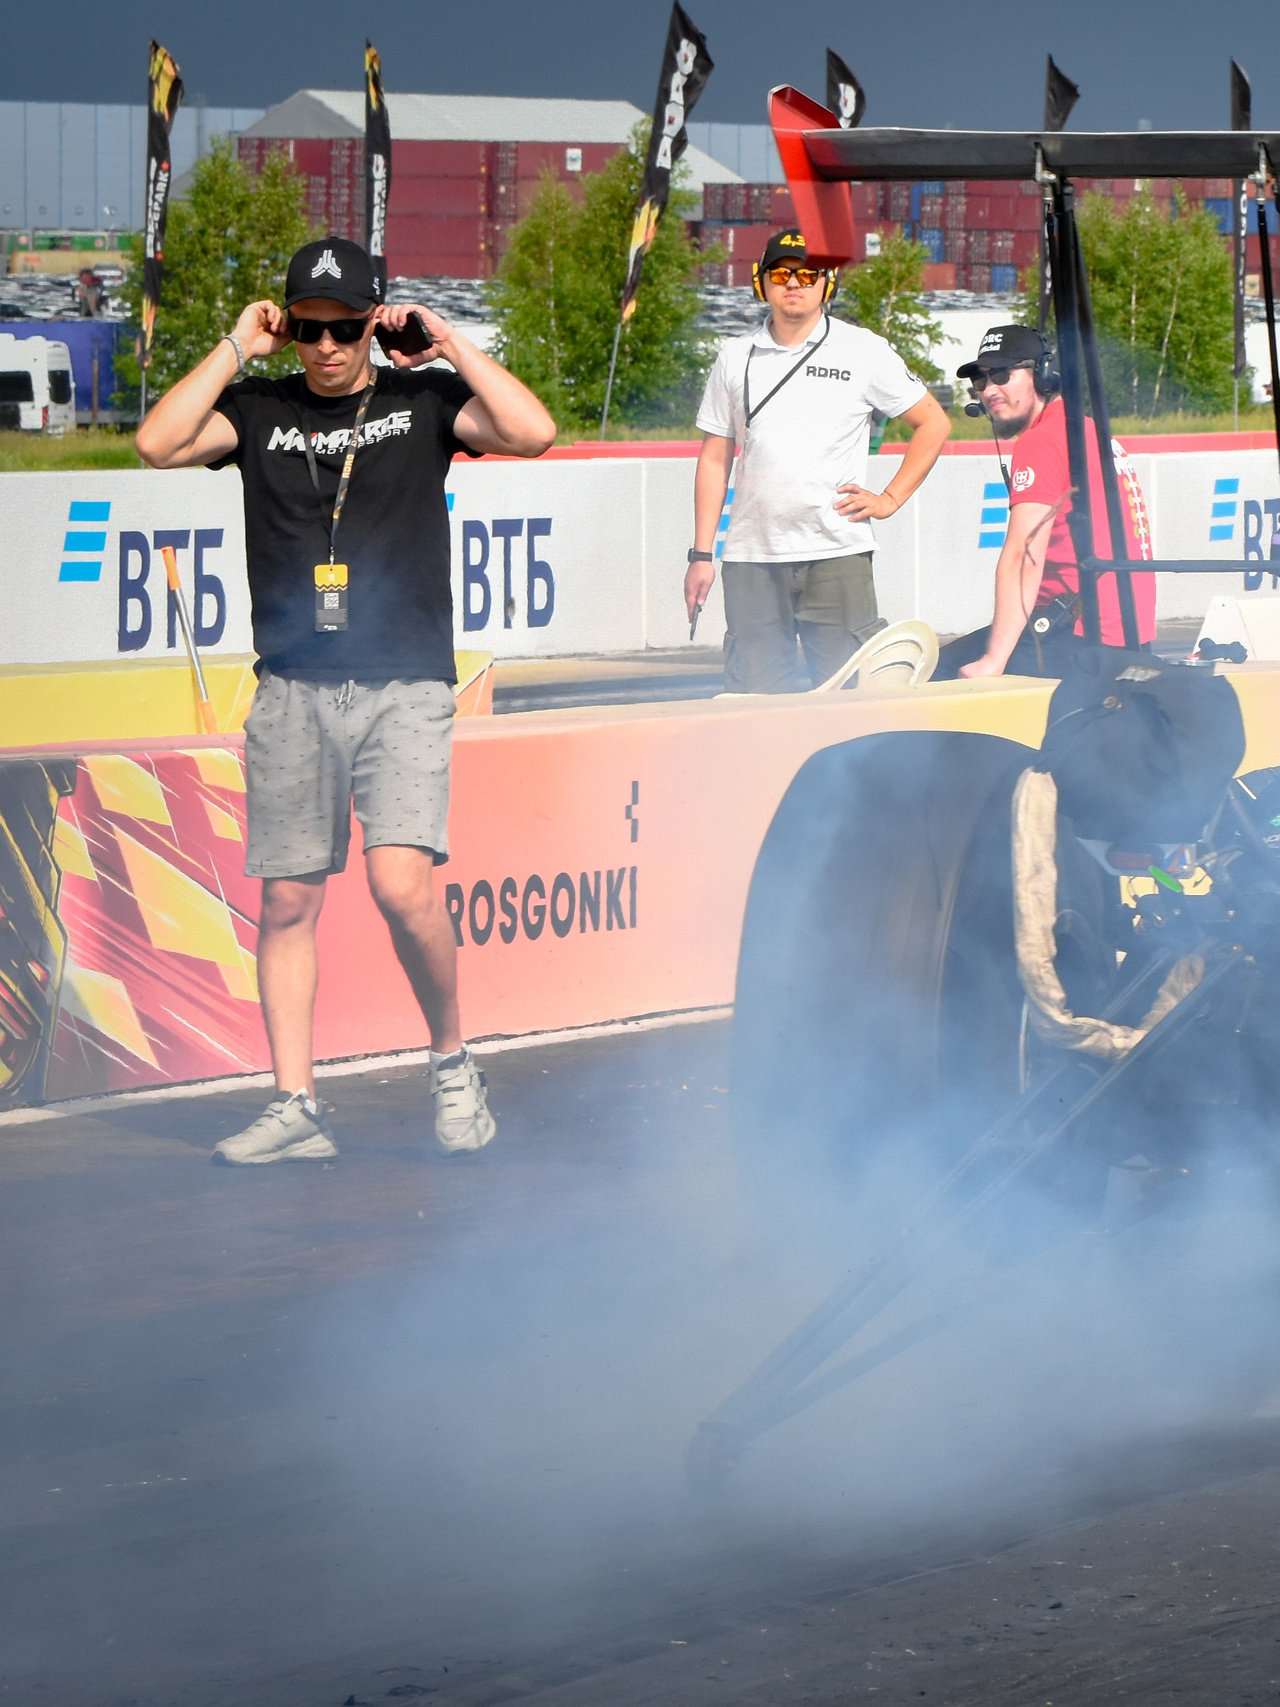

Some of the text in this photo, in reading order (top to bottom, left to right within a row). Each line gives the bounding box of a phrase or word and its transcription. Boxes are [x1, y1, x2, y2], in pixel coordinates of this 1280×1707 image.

[806, 365, 852, 382] RDRC
[118, 528, 227, 653] ВТБ
[462, 517, 556, 632] ВТБ
[445, 865, 638, 948] ROSGONKI
